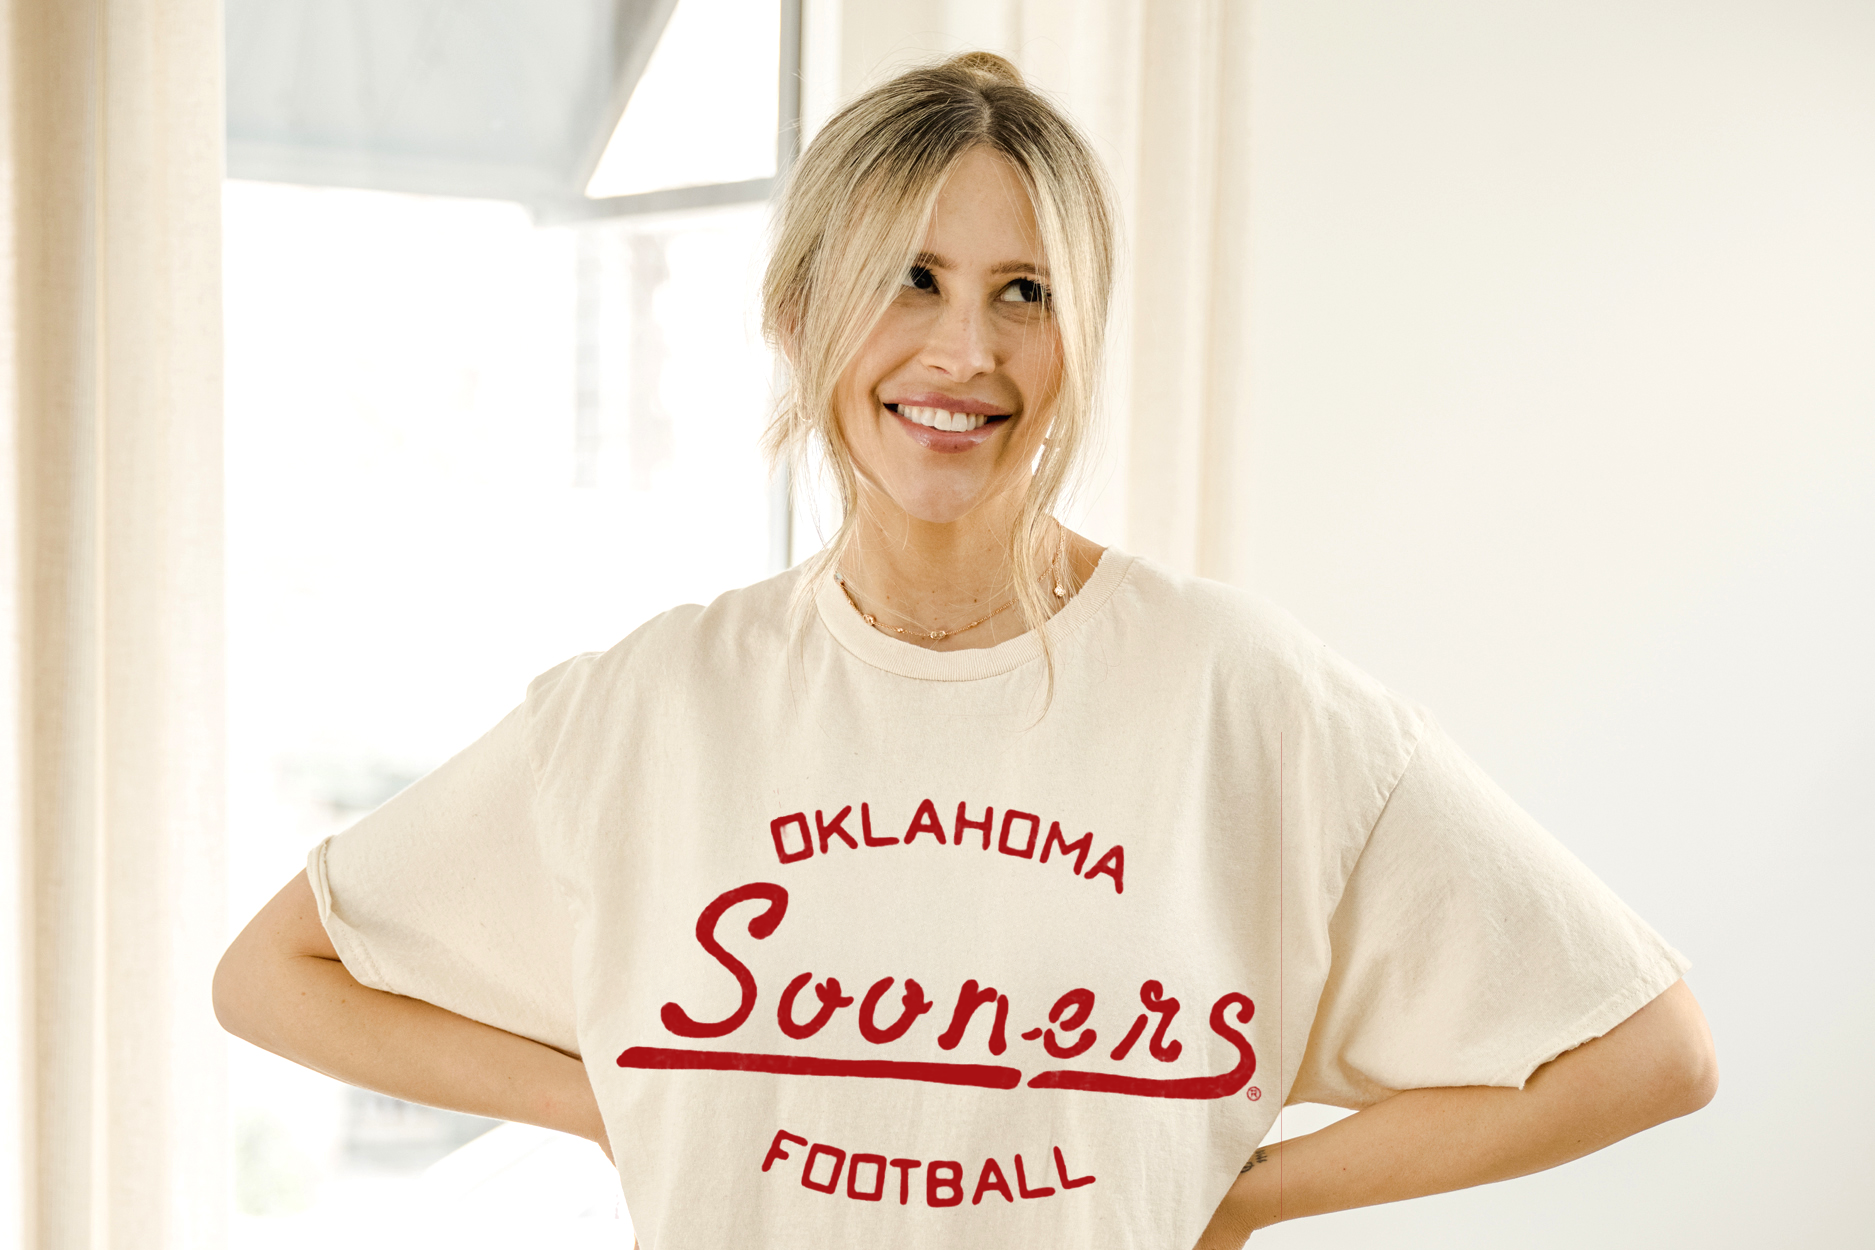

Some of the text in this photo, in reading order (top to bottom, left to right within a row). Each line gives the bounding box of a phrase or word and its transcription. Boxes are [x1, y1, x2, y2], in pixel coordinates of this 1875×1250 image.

[769, 798, 1125, 895] OKLAHOMA
[660, 881, 1257, 1101] Sooners
[761, 1129, 1097, 1209] FOOTBALL
